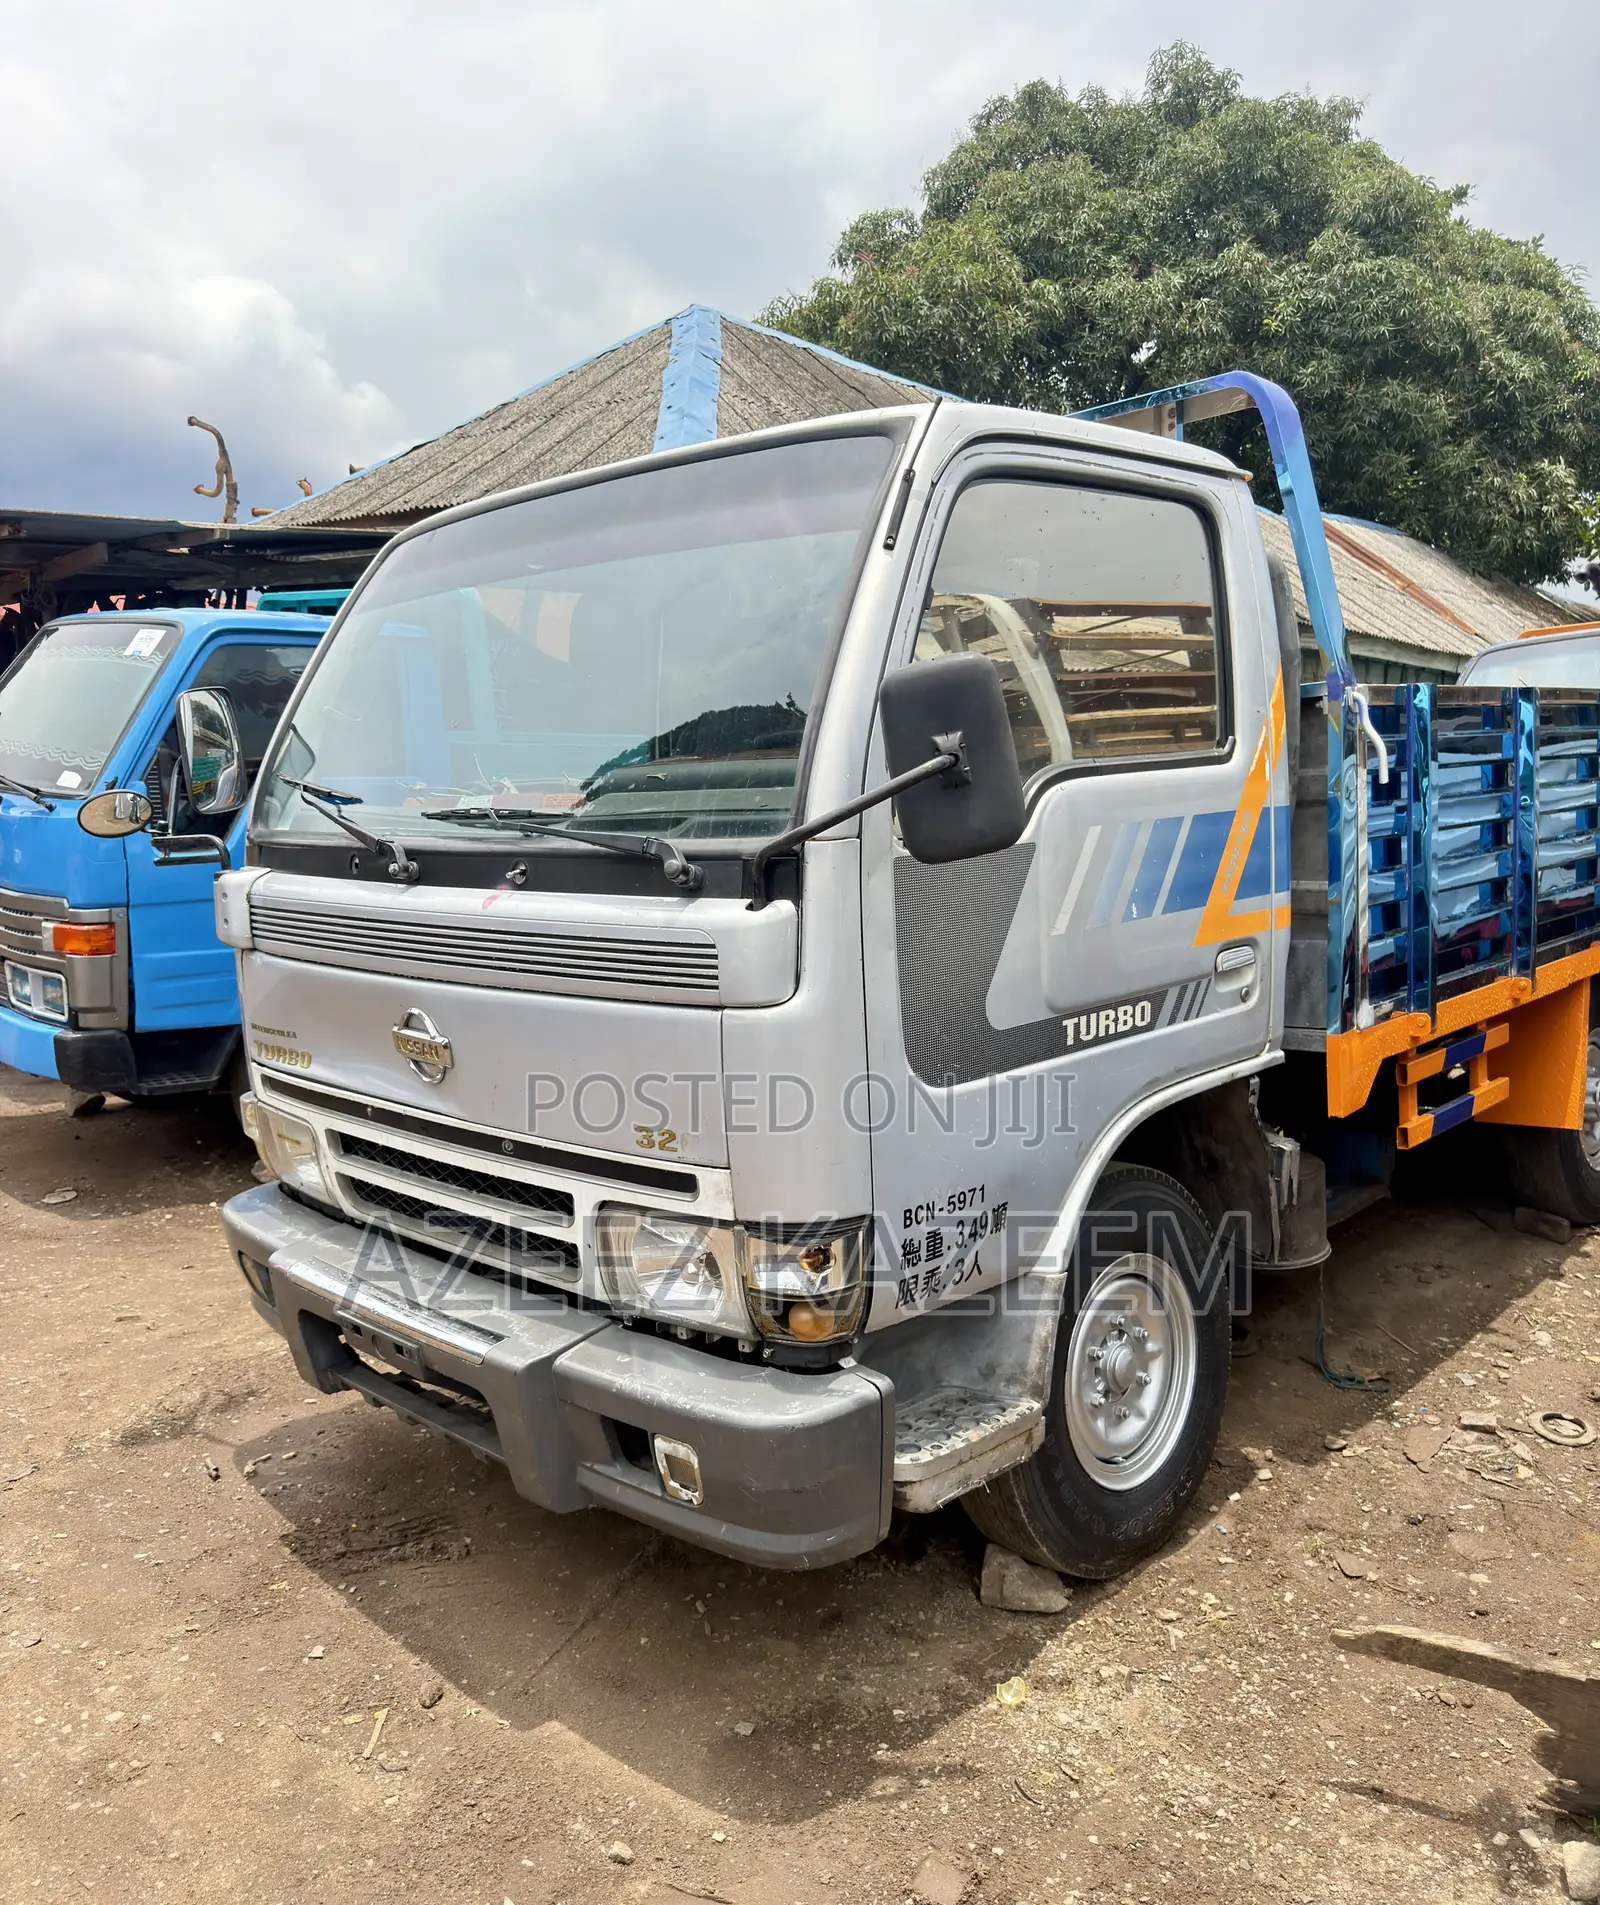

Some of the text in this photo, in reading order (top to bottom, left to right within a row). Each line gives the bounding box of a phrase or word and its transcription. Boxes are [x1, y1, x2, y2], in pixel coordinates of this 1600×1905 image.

[1062, 1000, 1152, 1046] TURBO
[254, 1039, 313, 1069] TURBO
[396, 1035, 441, 1061] NISSAN
[903, 1184, 985, 1229] BCN-5971
